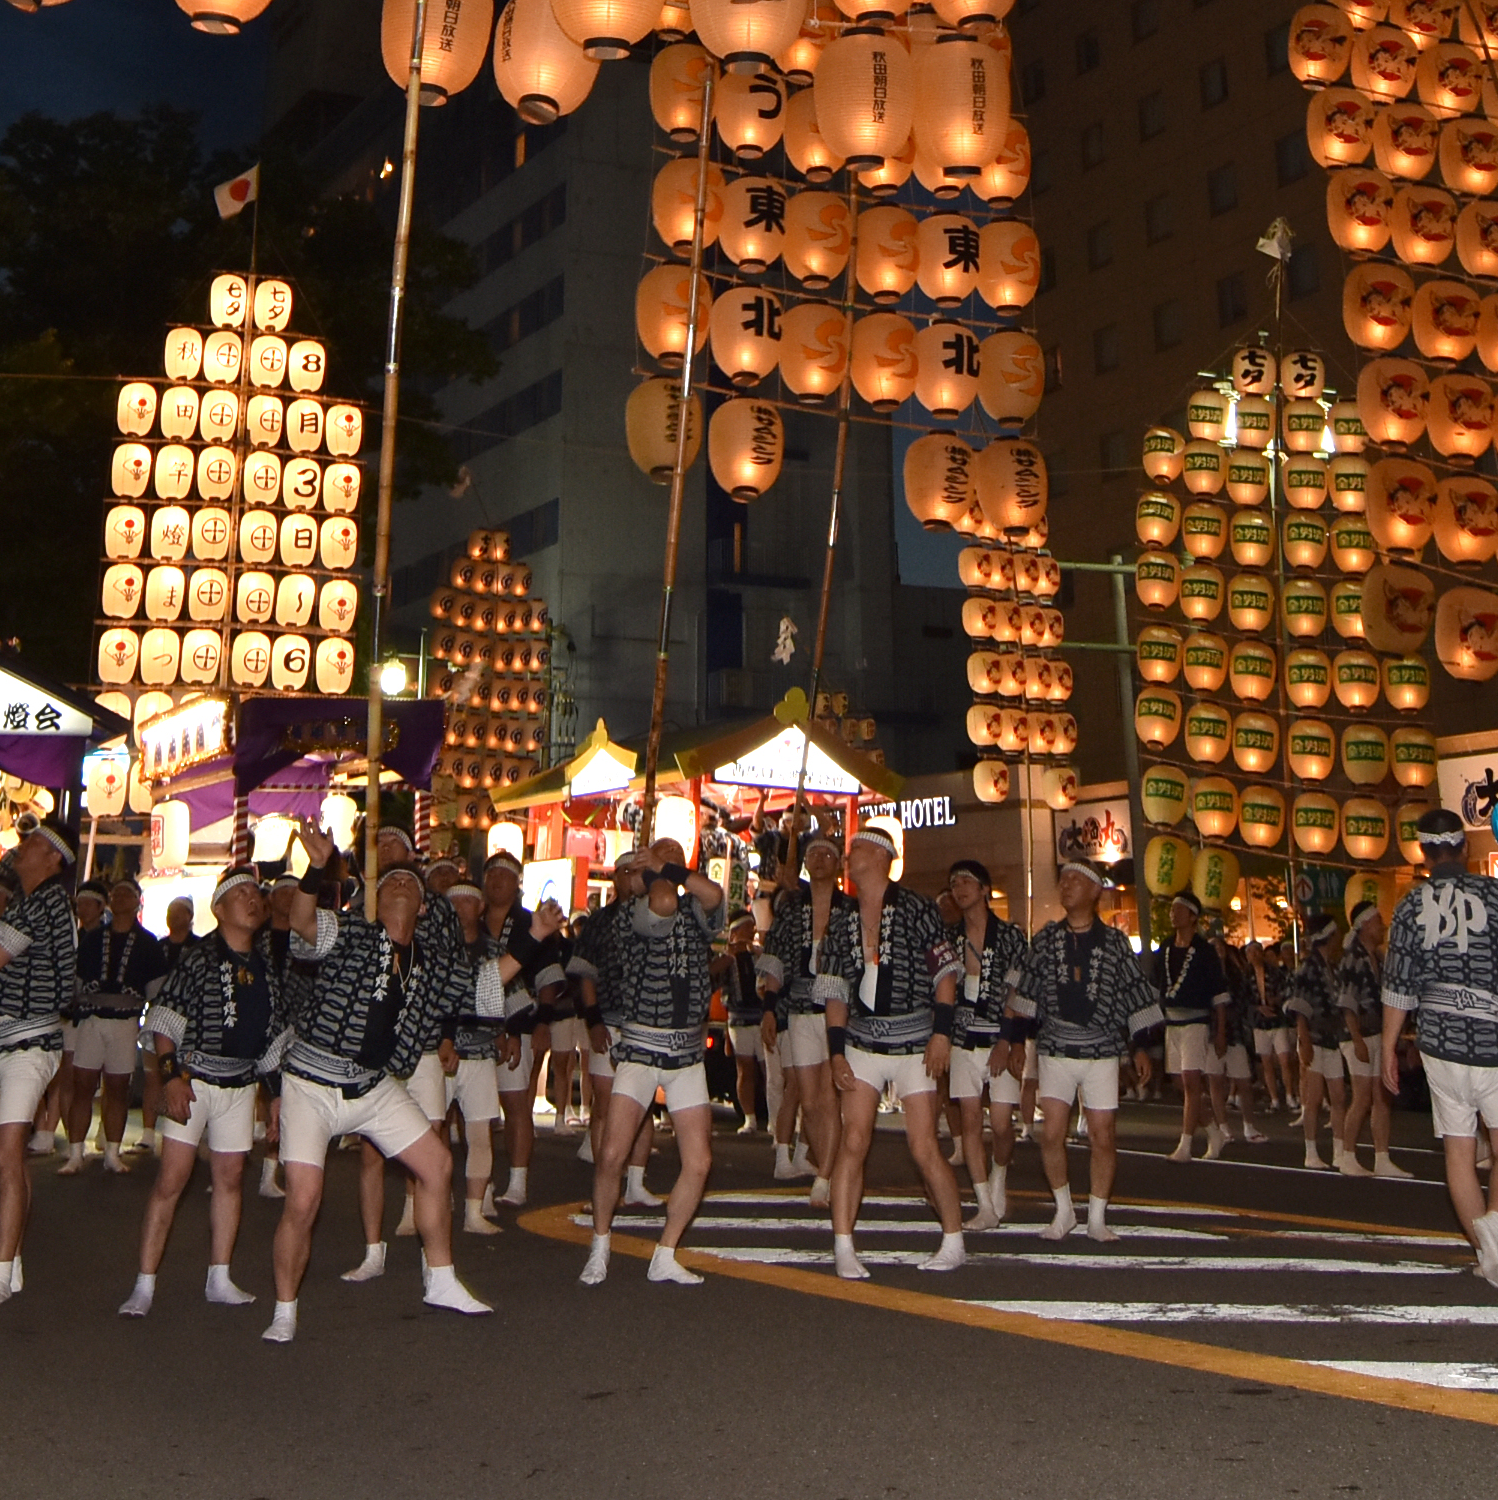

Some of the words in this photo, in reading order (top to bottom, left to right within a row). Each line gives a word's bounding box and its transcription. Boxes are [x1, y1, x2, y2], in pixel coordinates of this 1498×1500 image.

[872, 51, 887, 124] 秋田朝日放送
[971, 58, 986, 136] 秋田朝日放送
[226, 282, 243, 316] 七夕
[268, 286, 285, 320] 七夕
[1241, 351, 1267, 387] 七夕
[1292, 355, 1317, 390] 七夕
[901, 796, 956, 830] HOTEL
[1415, 883, 1488, 954] 柳
